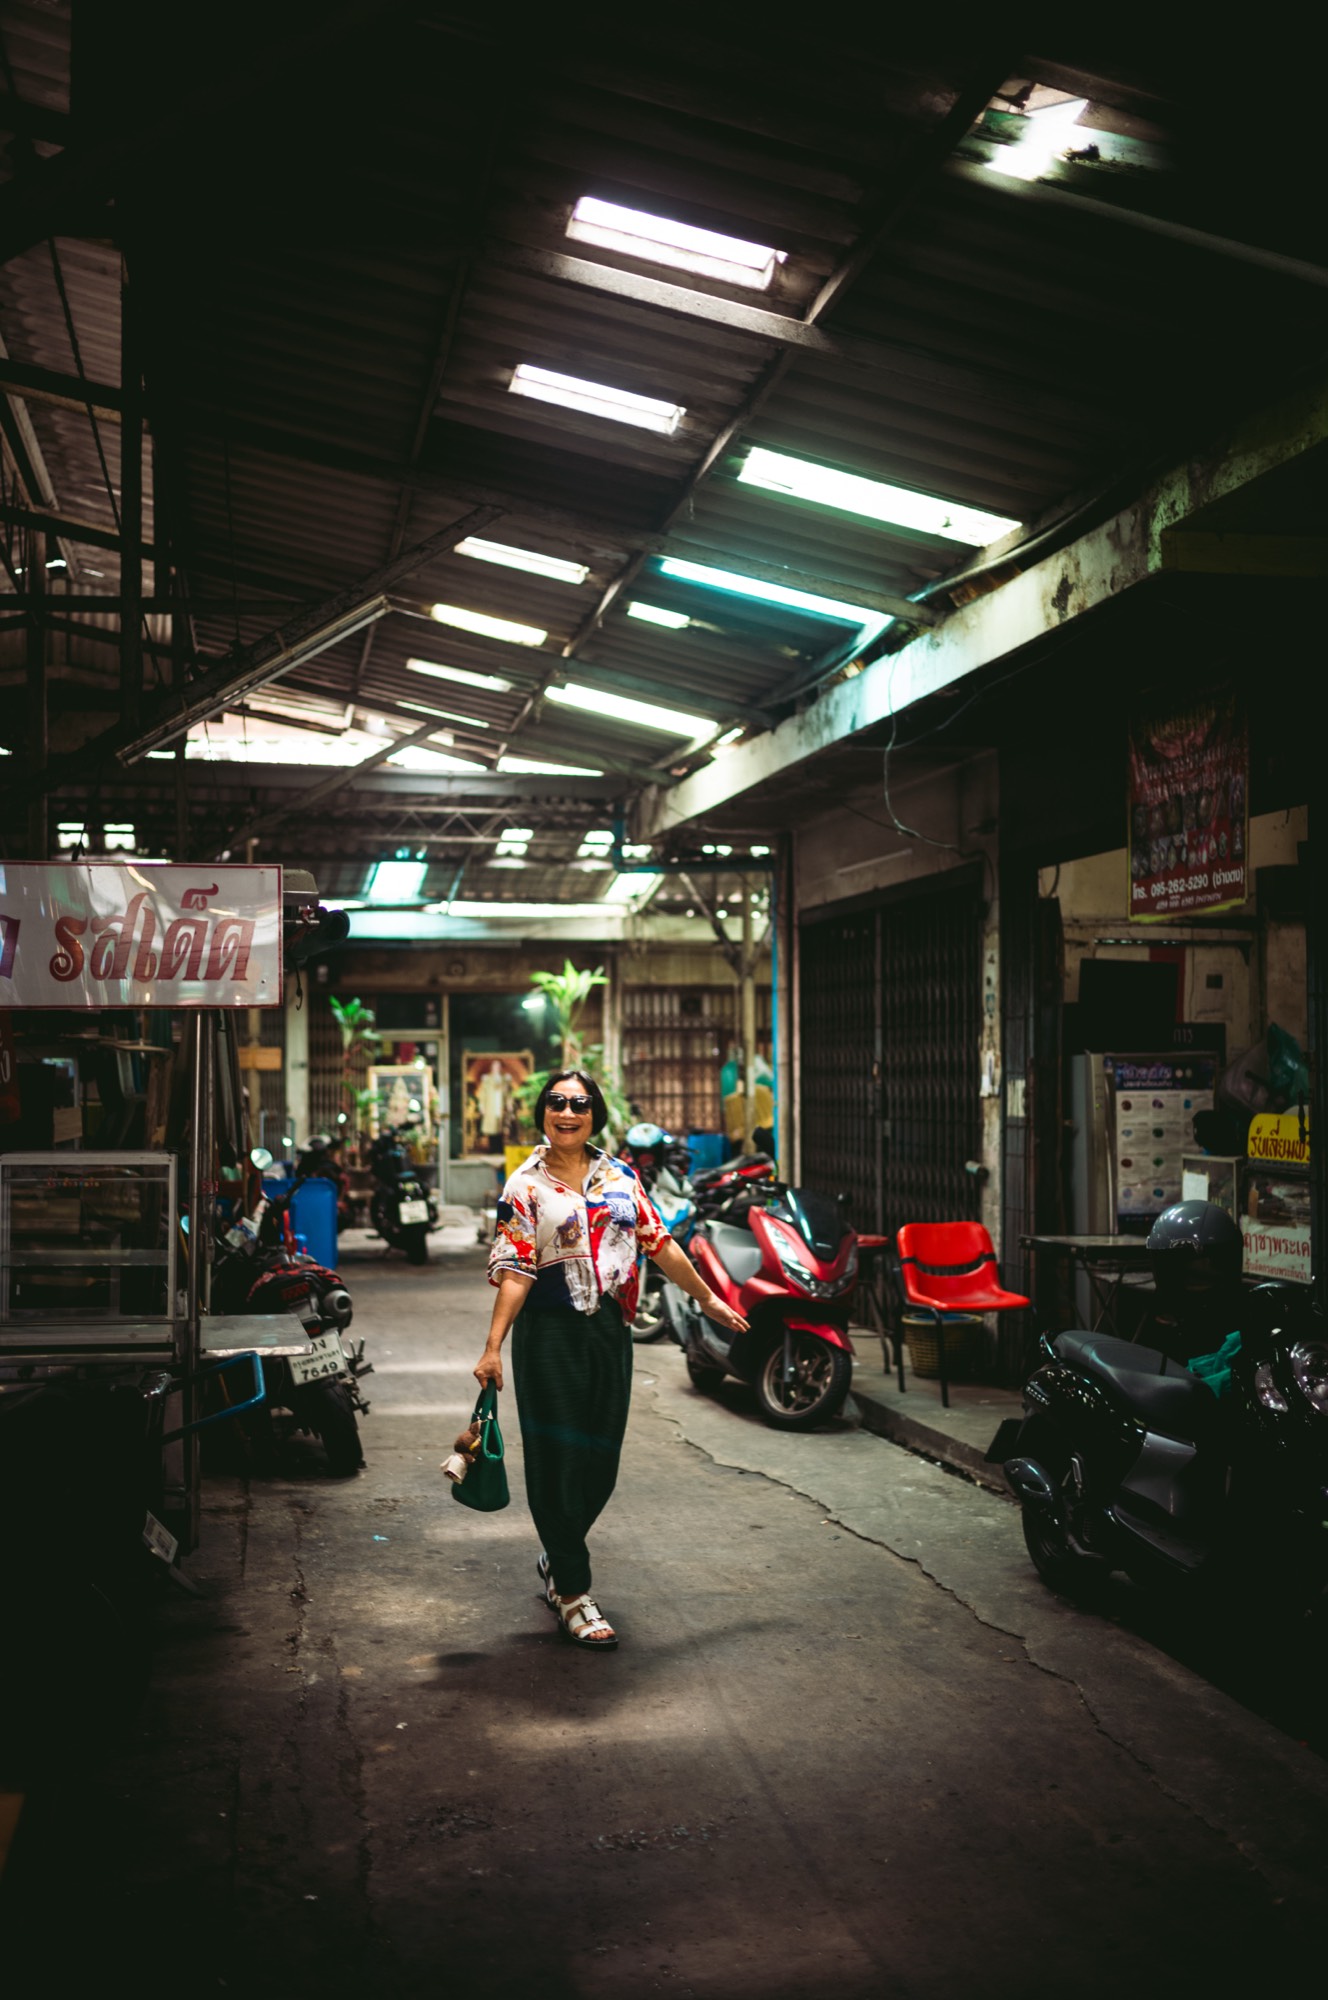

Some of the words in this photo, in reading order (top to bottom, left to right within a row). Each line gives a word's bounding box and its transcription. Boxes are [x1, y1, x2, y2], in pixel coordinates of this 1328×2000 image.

[49, 883, 256, 982] รสเด็ด
[301, 1361, 338, 1381] 7649
